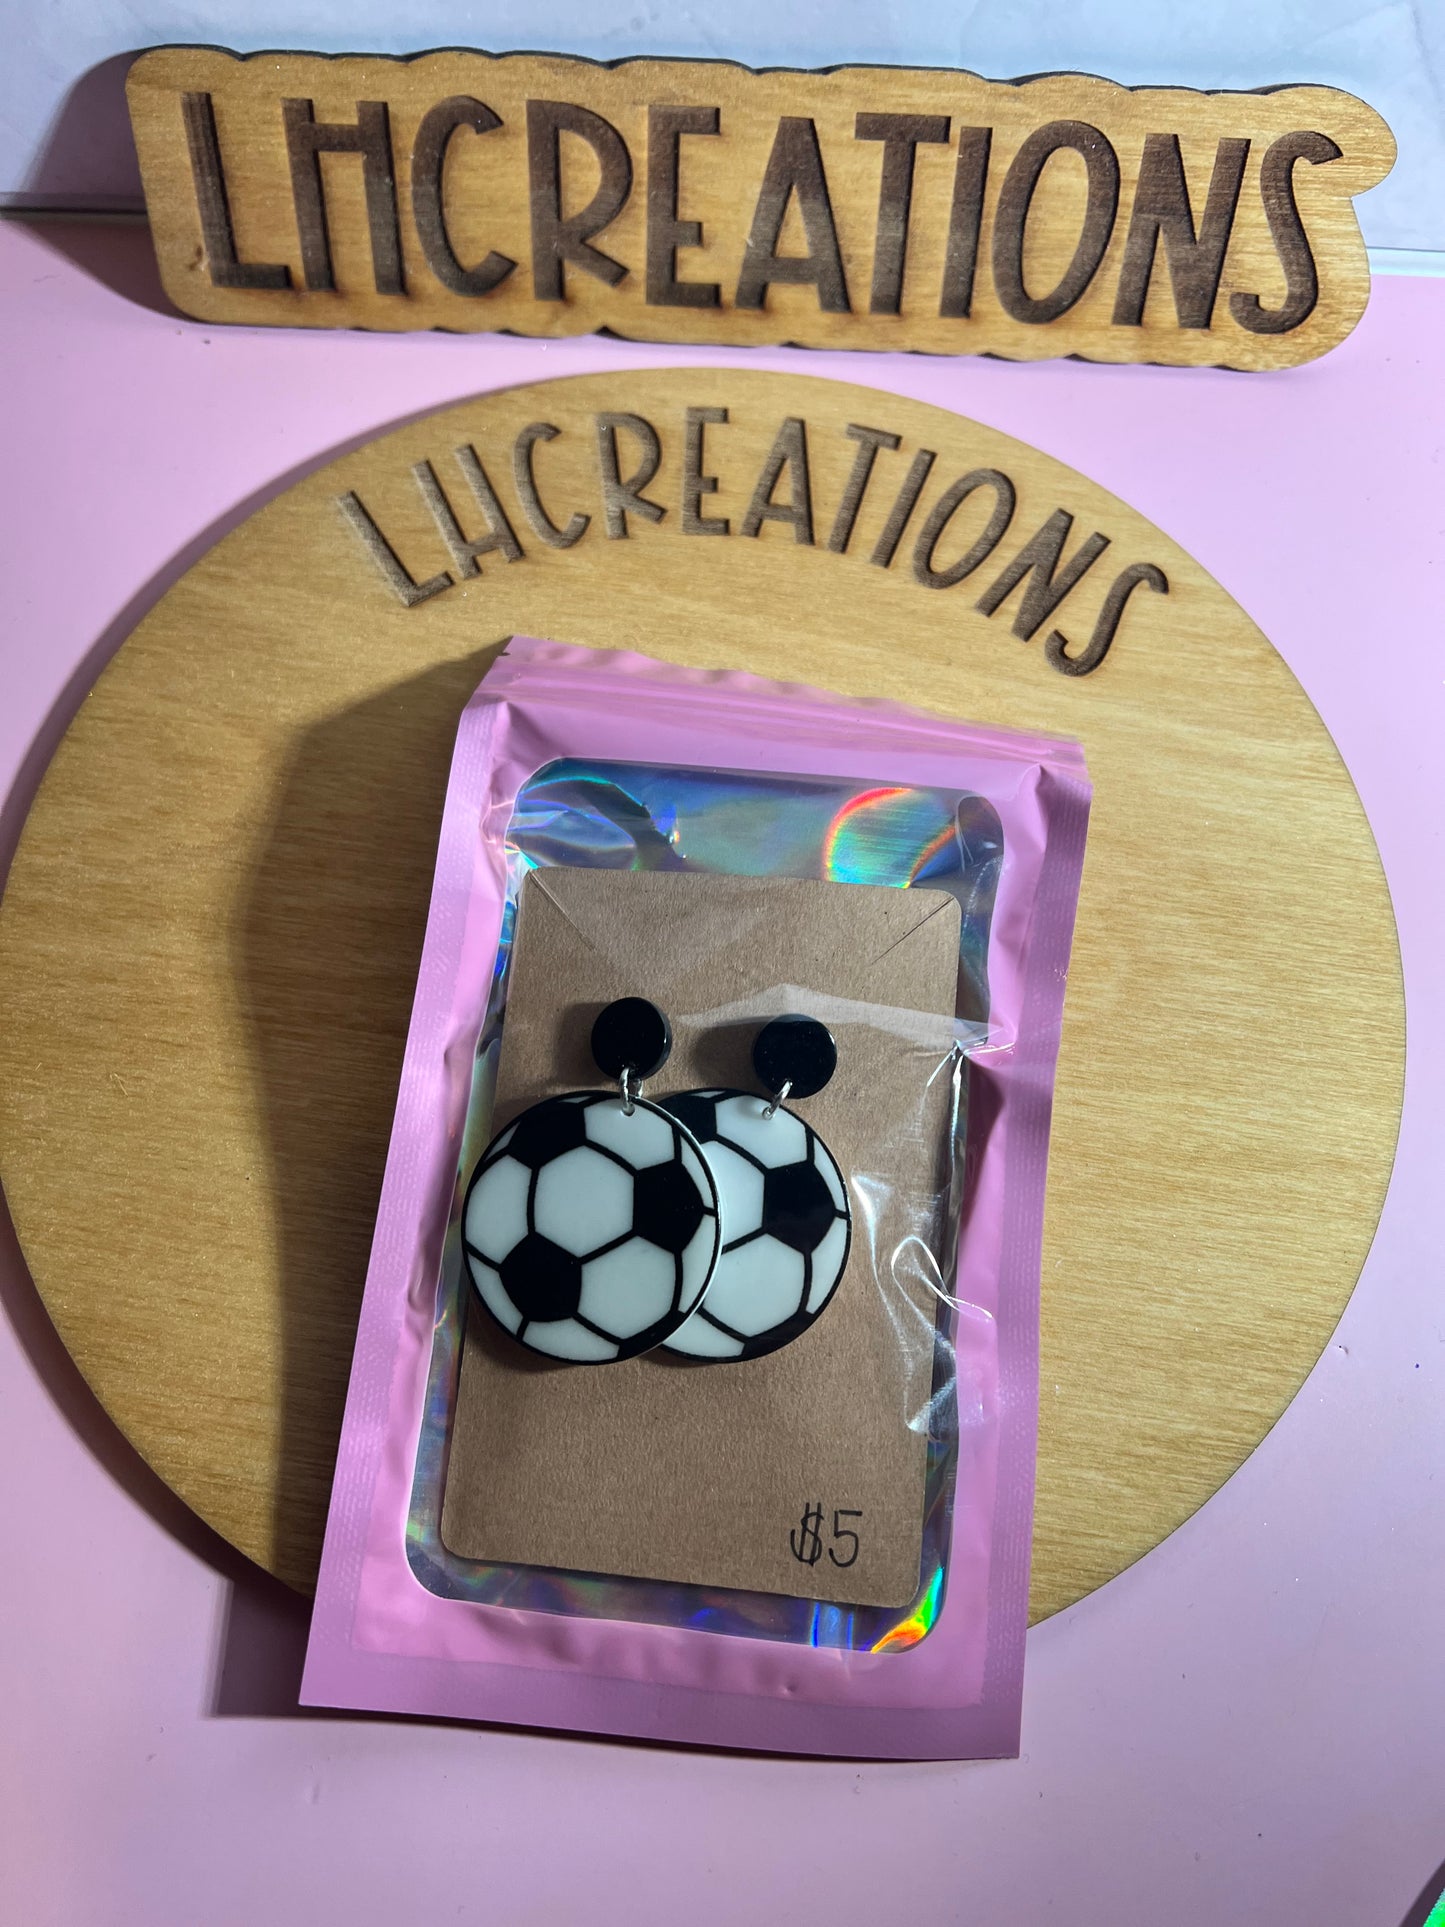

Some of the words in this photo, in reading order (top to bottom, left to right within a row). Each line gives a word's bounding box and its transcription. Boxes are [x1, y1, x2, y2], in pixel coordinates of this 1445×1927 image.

[182, 90, 1343, 335] LHCREATIONS
[336, 406, 1170, 677] LHCREATIONS
[790, 1502, 863, 1568] $5
